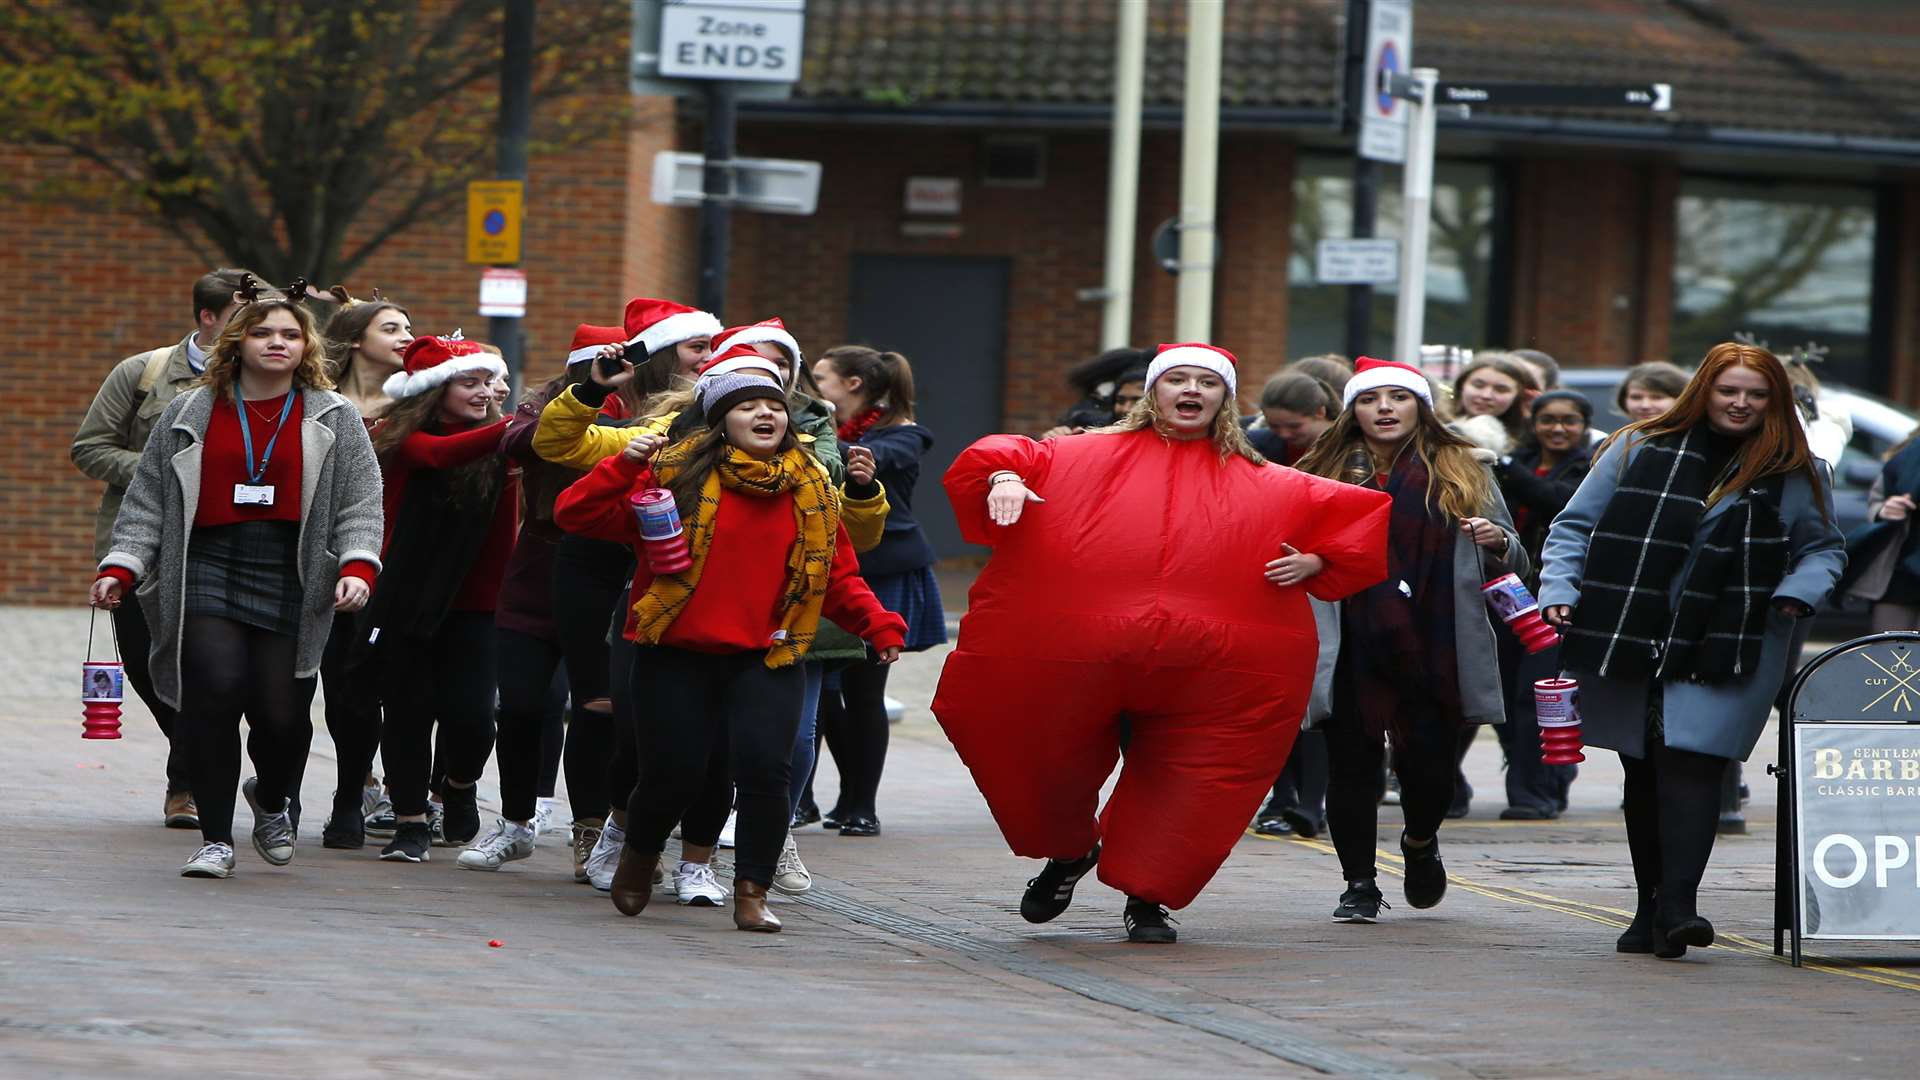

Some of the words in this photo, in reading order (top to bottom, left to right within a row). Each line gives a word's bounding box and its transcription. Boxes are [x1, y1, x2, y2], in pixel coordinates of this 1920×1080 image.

[698, 16, 767, 37] Zone
[676, 42, 786, 70] ENDS
[1864, 678, 1888, 686] CUT
[1813, 748, 1920, 780] BARB
[1818, 785, 1880, 796] CLASSIC
[1887, 786, 1920, 796] BAR
